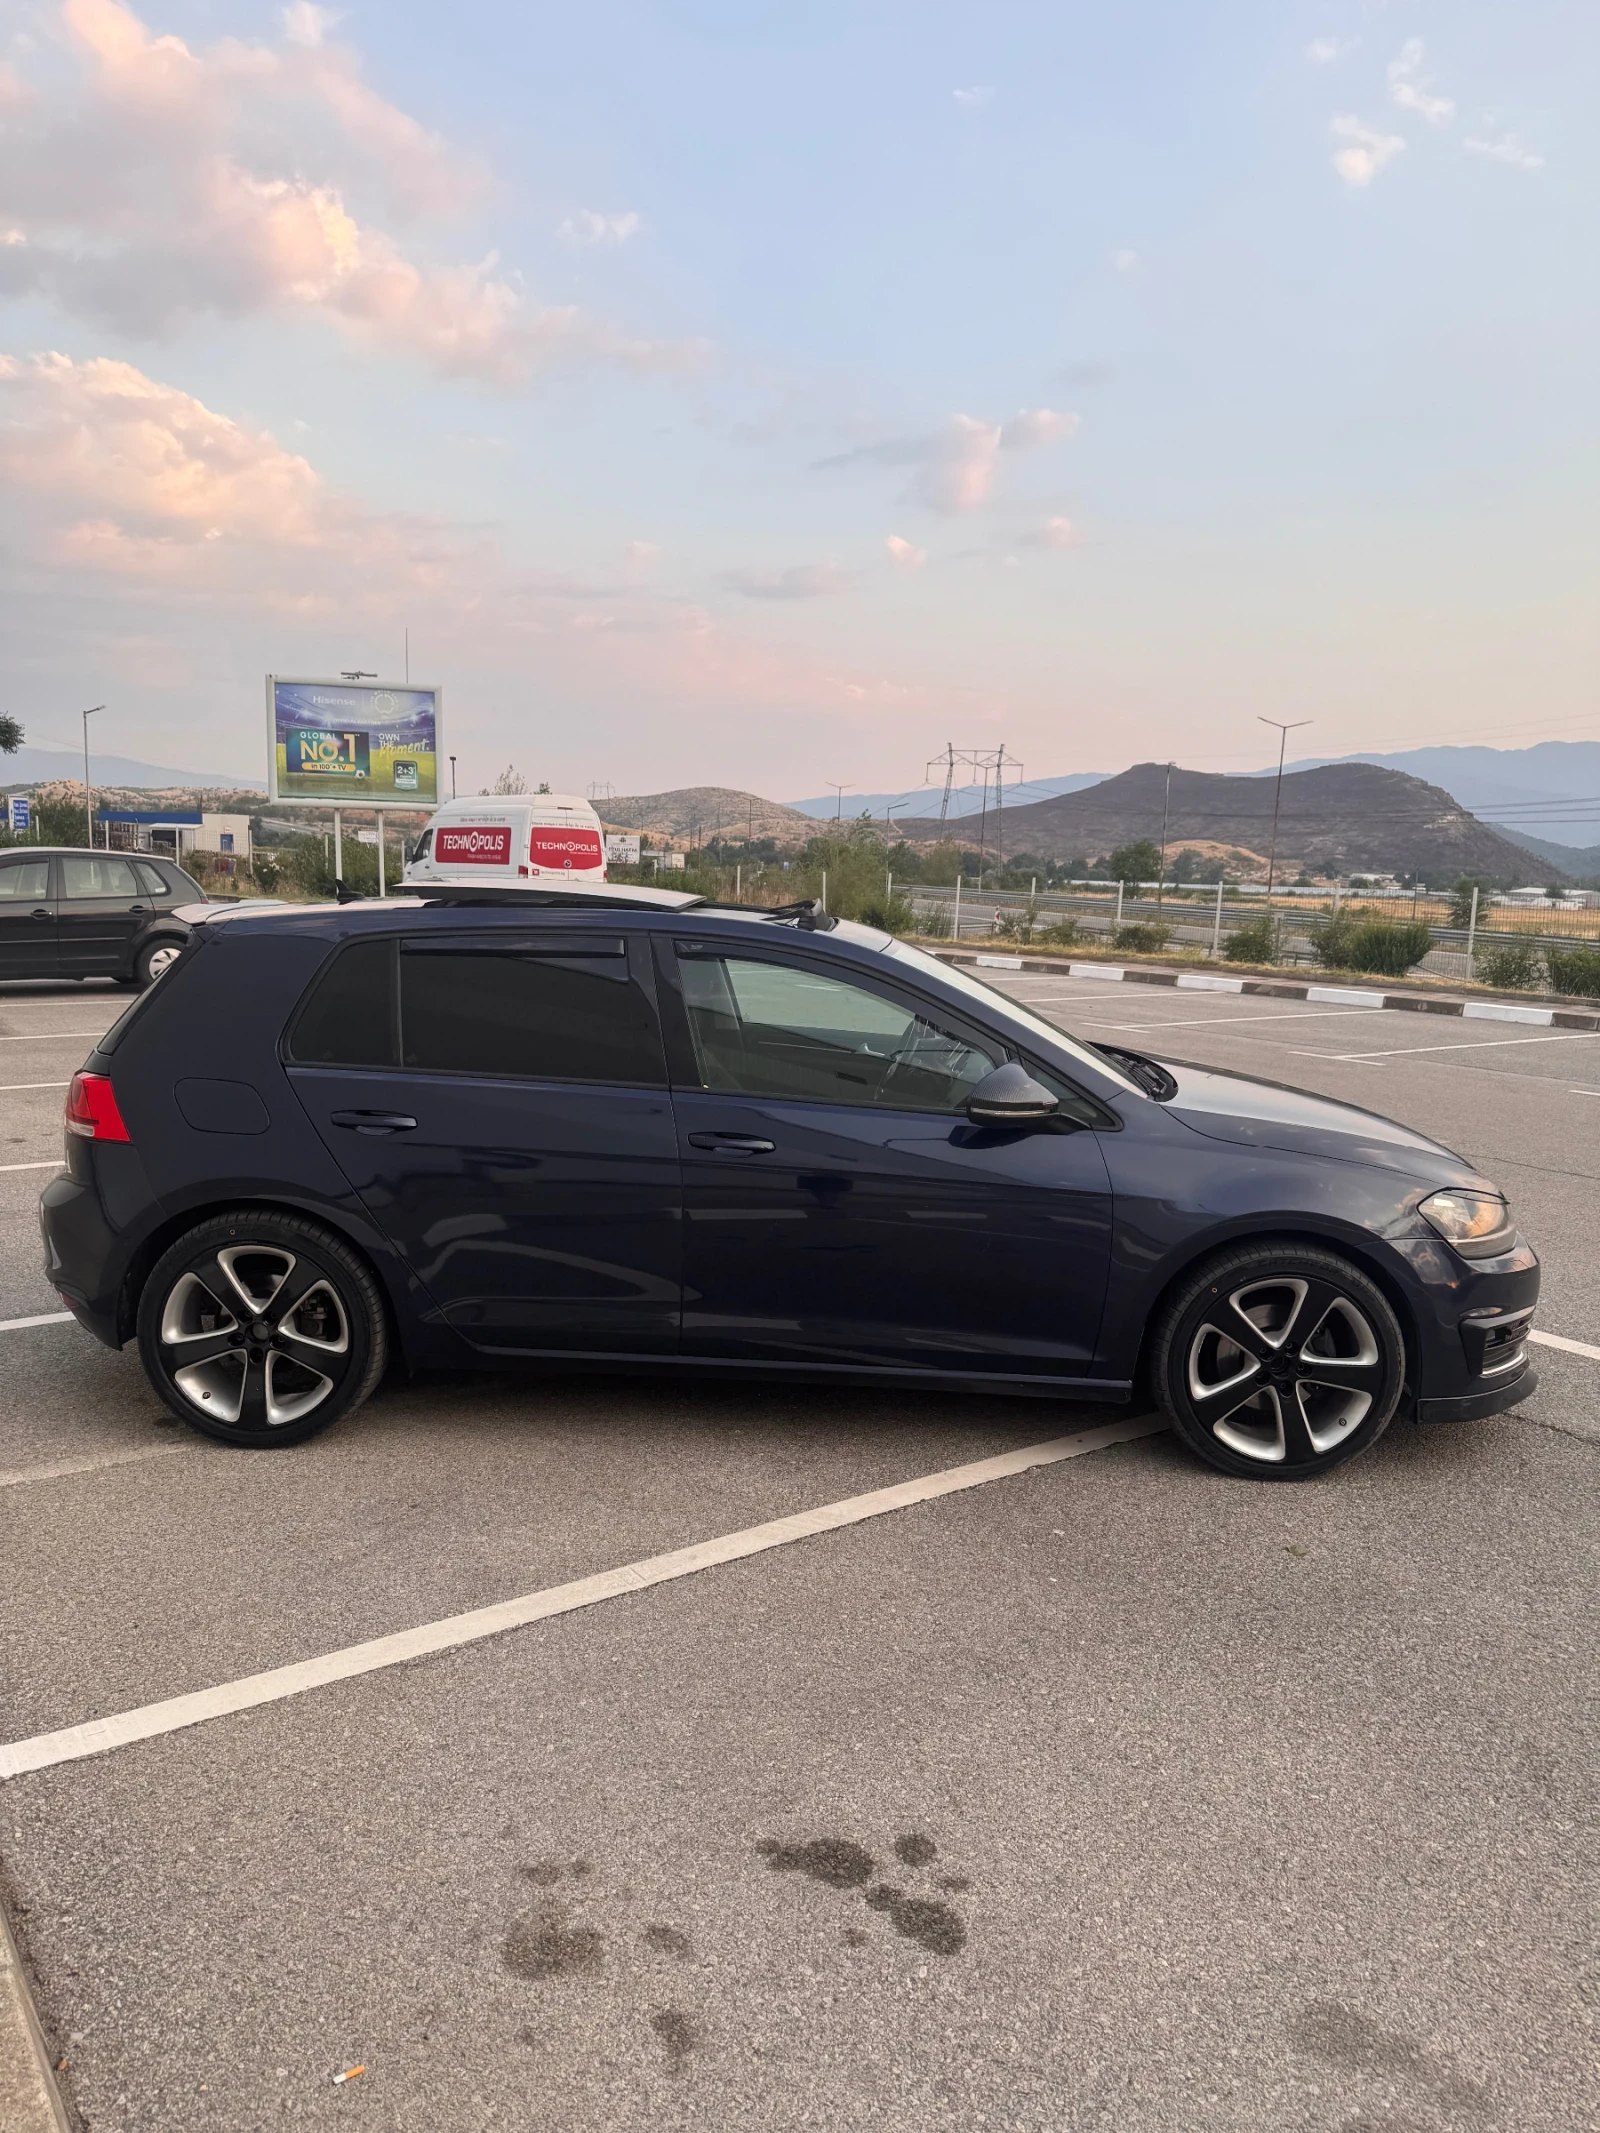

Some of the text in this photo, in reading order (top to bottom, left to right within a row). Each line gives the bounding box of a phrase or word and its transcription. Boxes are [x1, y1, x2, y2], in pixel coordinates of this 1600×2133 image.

[312, 695, 356, 706] Hisense
[300, 731, 337, 740] GLOBAL
[378, 732, 400, 741] OWN
[378, 740, 394, 748] THE
[443, 831, 504, 852] TECHNOPOLIS
[536, 841, 599, 853] TECHNOPOLIS
